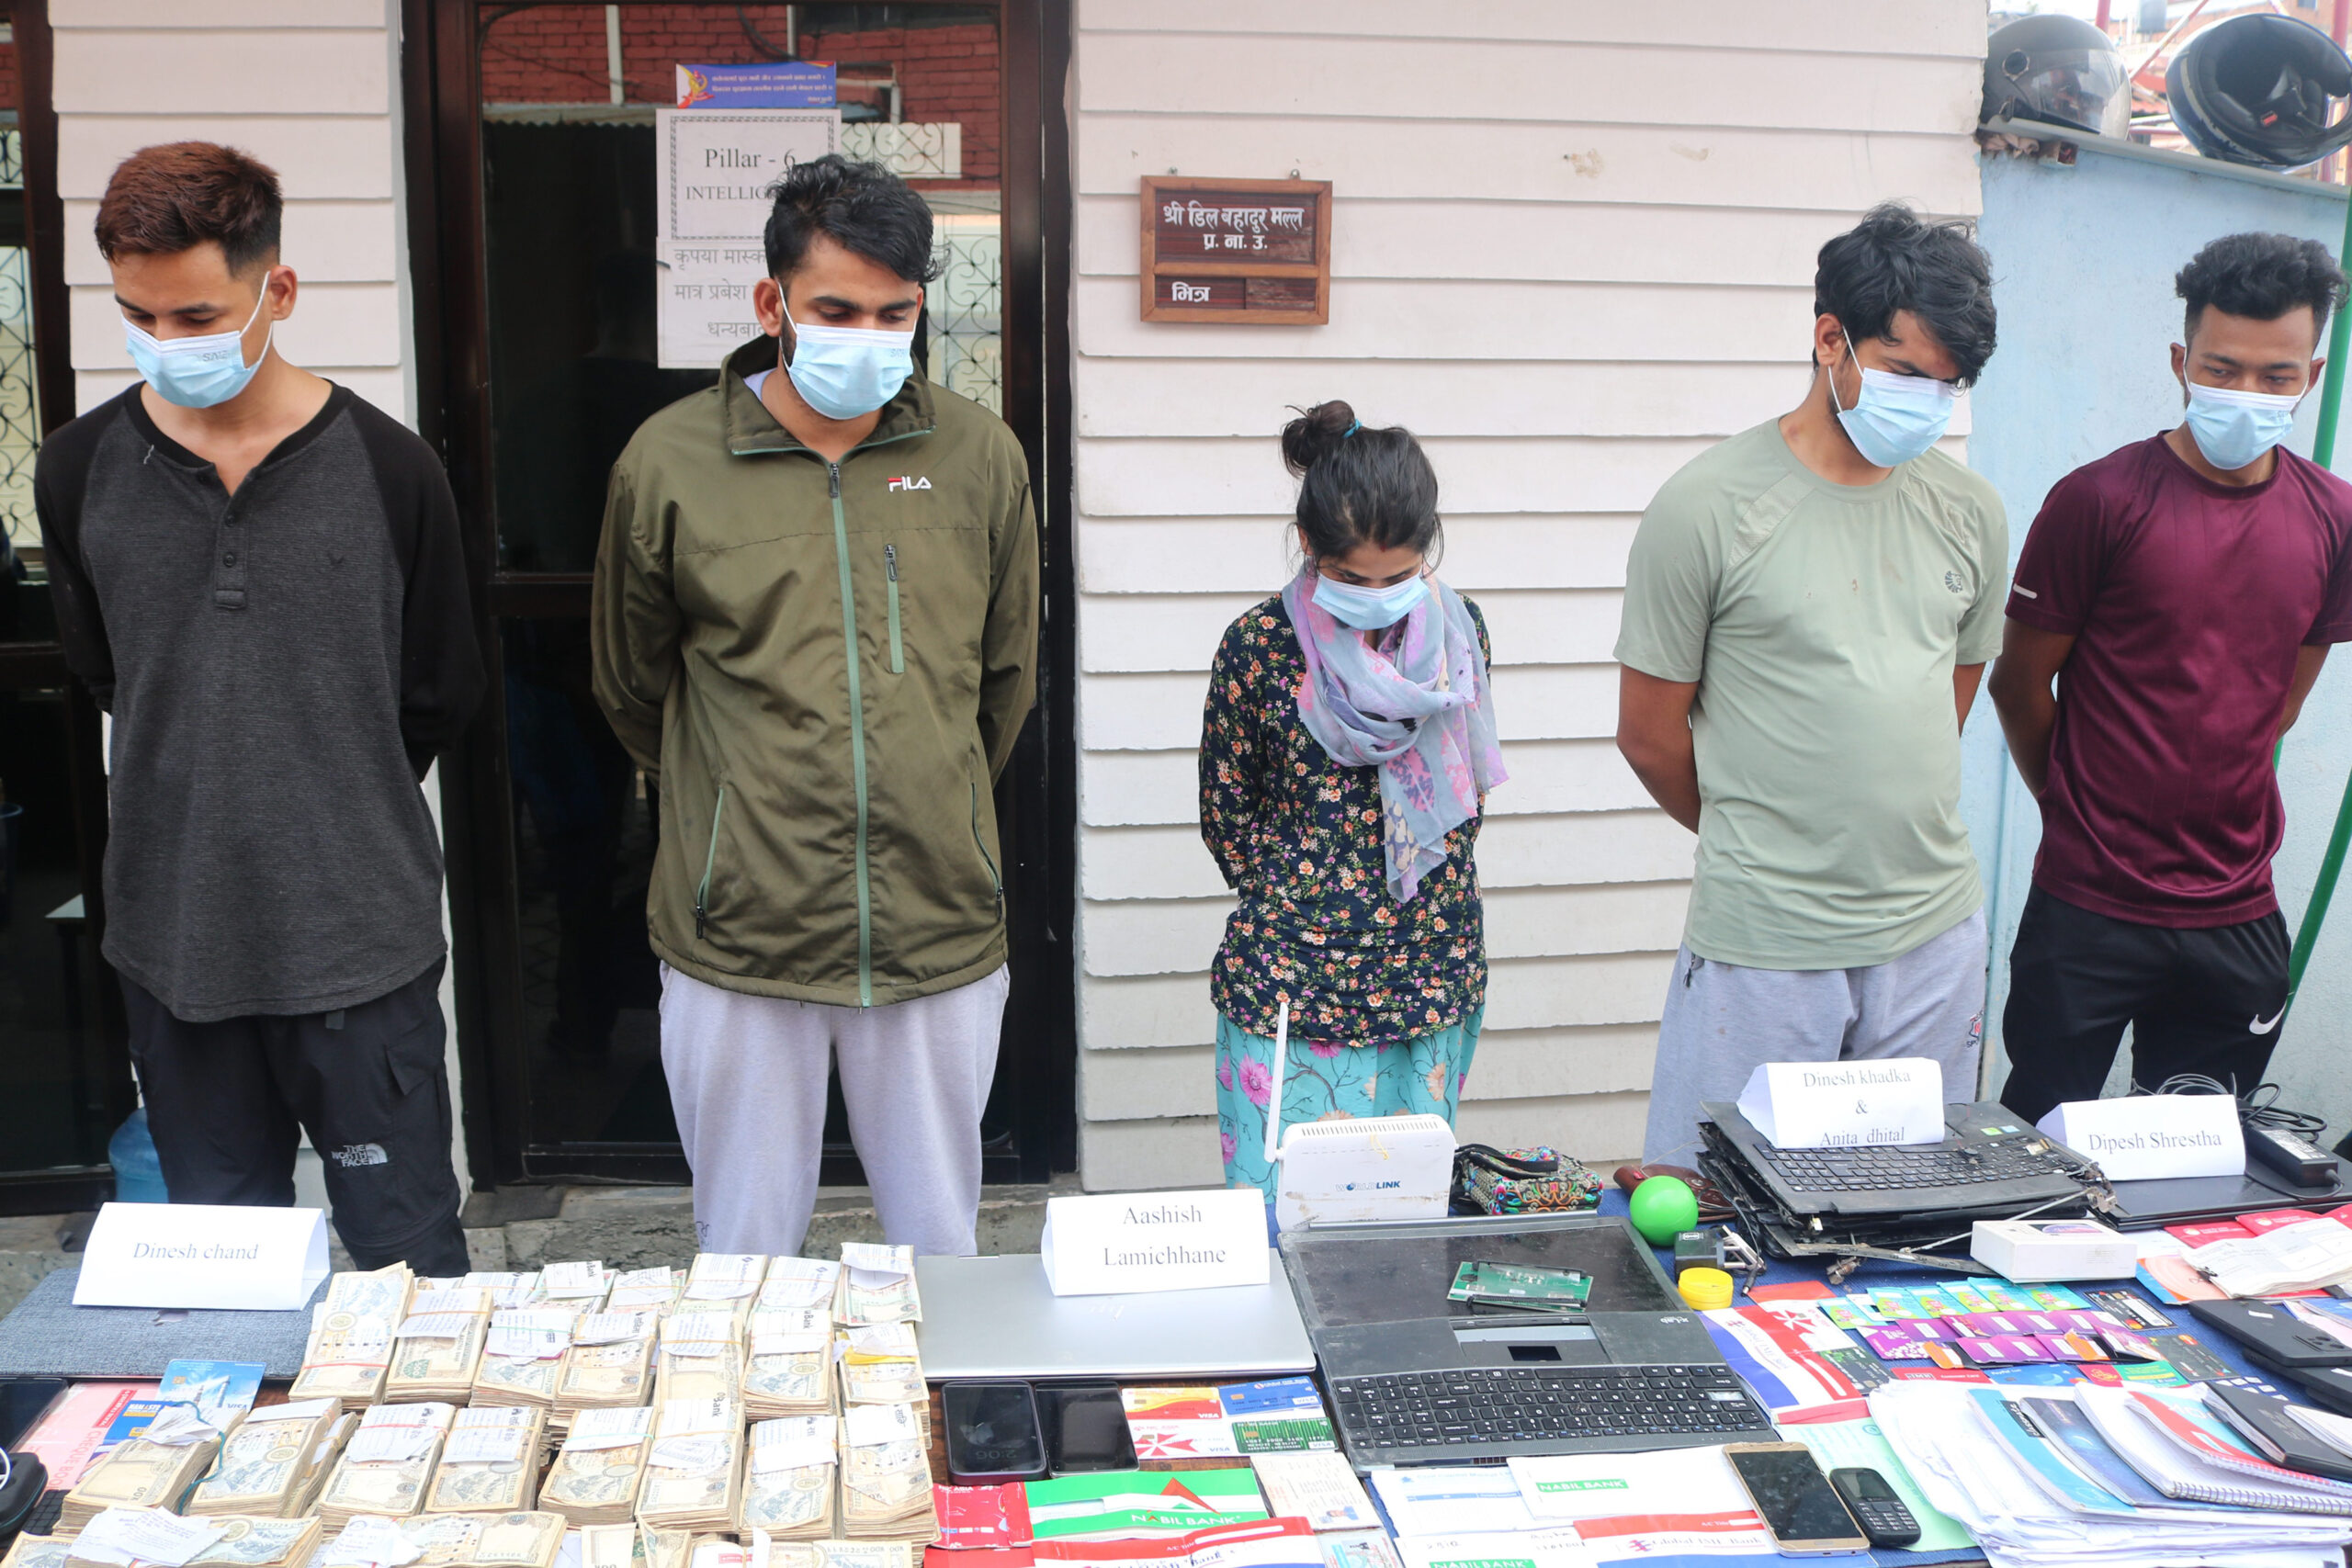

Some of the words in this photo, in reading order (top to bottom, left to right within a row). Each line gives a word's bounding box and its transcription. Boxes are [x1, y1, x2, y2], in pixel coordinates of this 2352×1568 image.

[705, 148, 762, 168] Pillar
[784, 148, 796, 169] 6
[685, 186, 768, 200] INTELLIG
[1163, 201, 1185, 226] श्री
[1187, 199, 1220, 229] डिल
[1221, 207, 1269, 234] बहादुर
[1270, 207, 1305, 231] मल्ल
[1224, 233, 1248, 250] ना.
[1252, 234, 1268, 250] उ.
[673, 248, 719, 271] कृपया
[673, 284, 704, 300] मात्र
[707, 277, 748, 300] प्रबेश
[1171, 281, 1211, 302] भित्र
[888, 476, 933, 492] FILA
[1802, 1070, 1856, 1089] Dinesh
[1859, 1068, 1912, 1085] khadka
[1855, 1099, 1869, 1115] &
[1820, 1129, 1859, 1147] Anita
[1866, 1126, 1905, 1145] dhital
[2087, 1132, 2146, 1156] Dipesh
[2149, 1130, 2222, 1149] Shrestha
[331, 1150, 368, 1160] NORTH
[343, 1144, 366, 1154] THE
[341, 1158, 369, 1168] FACE
[1122, 1204, 1203, 1225] Aashish
[132, 1241, 198, 1259] Dinesh
[203, 1243, 260, 1260] chand
[1103, 1245, 1227, 1267] Lamichhane
[1539, 1482, 1581, 1493] NABIL
[1583, 1479, 1624, 1491] BANK
[1131, 1509, 1183, 1526] NABIL
[1186, 1516, 1237, 1527] BANK
[1652, 1537, 1693, 1546] Global
[1729, 1536, 1763, 1545] Bank
